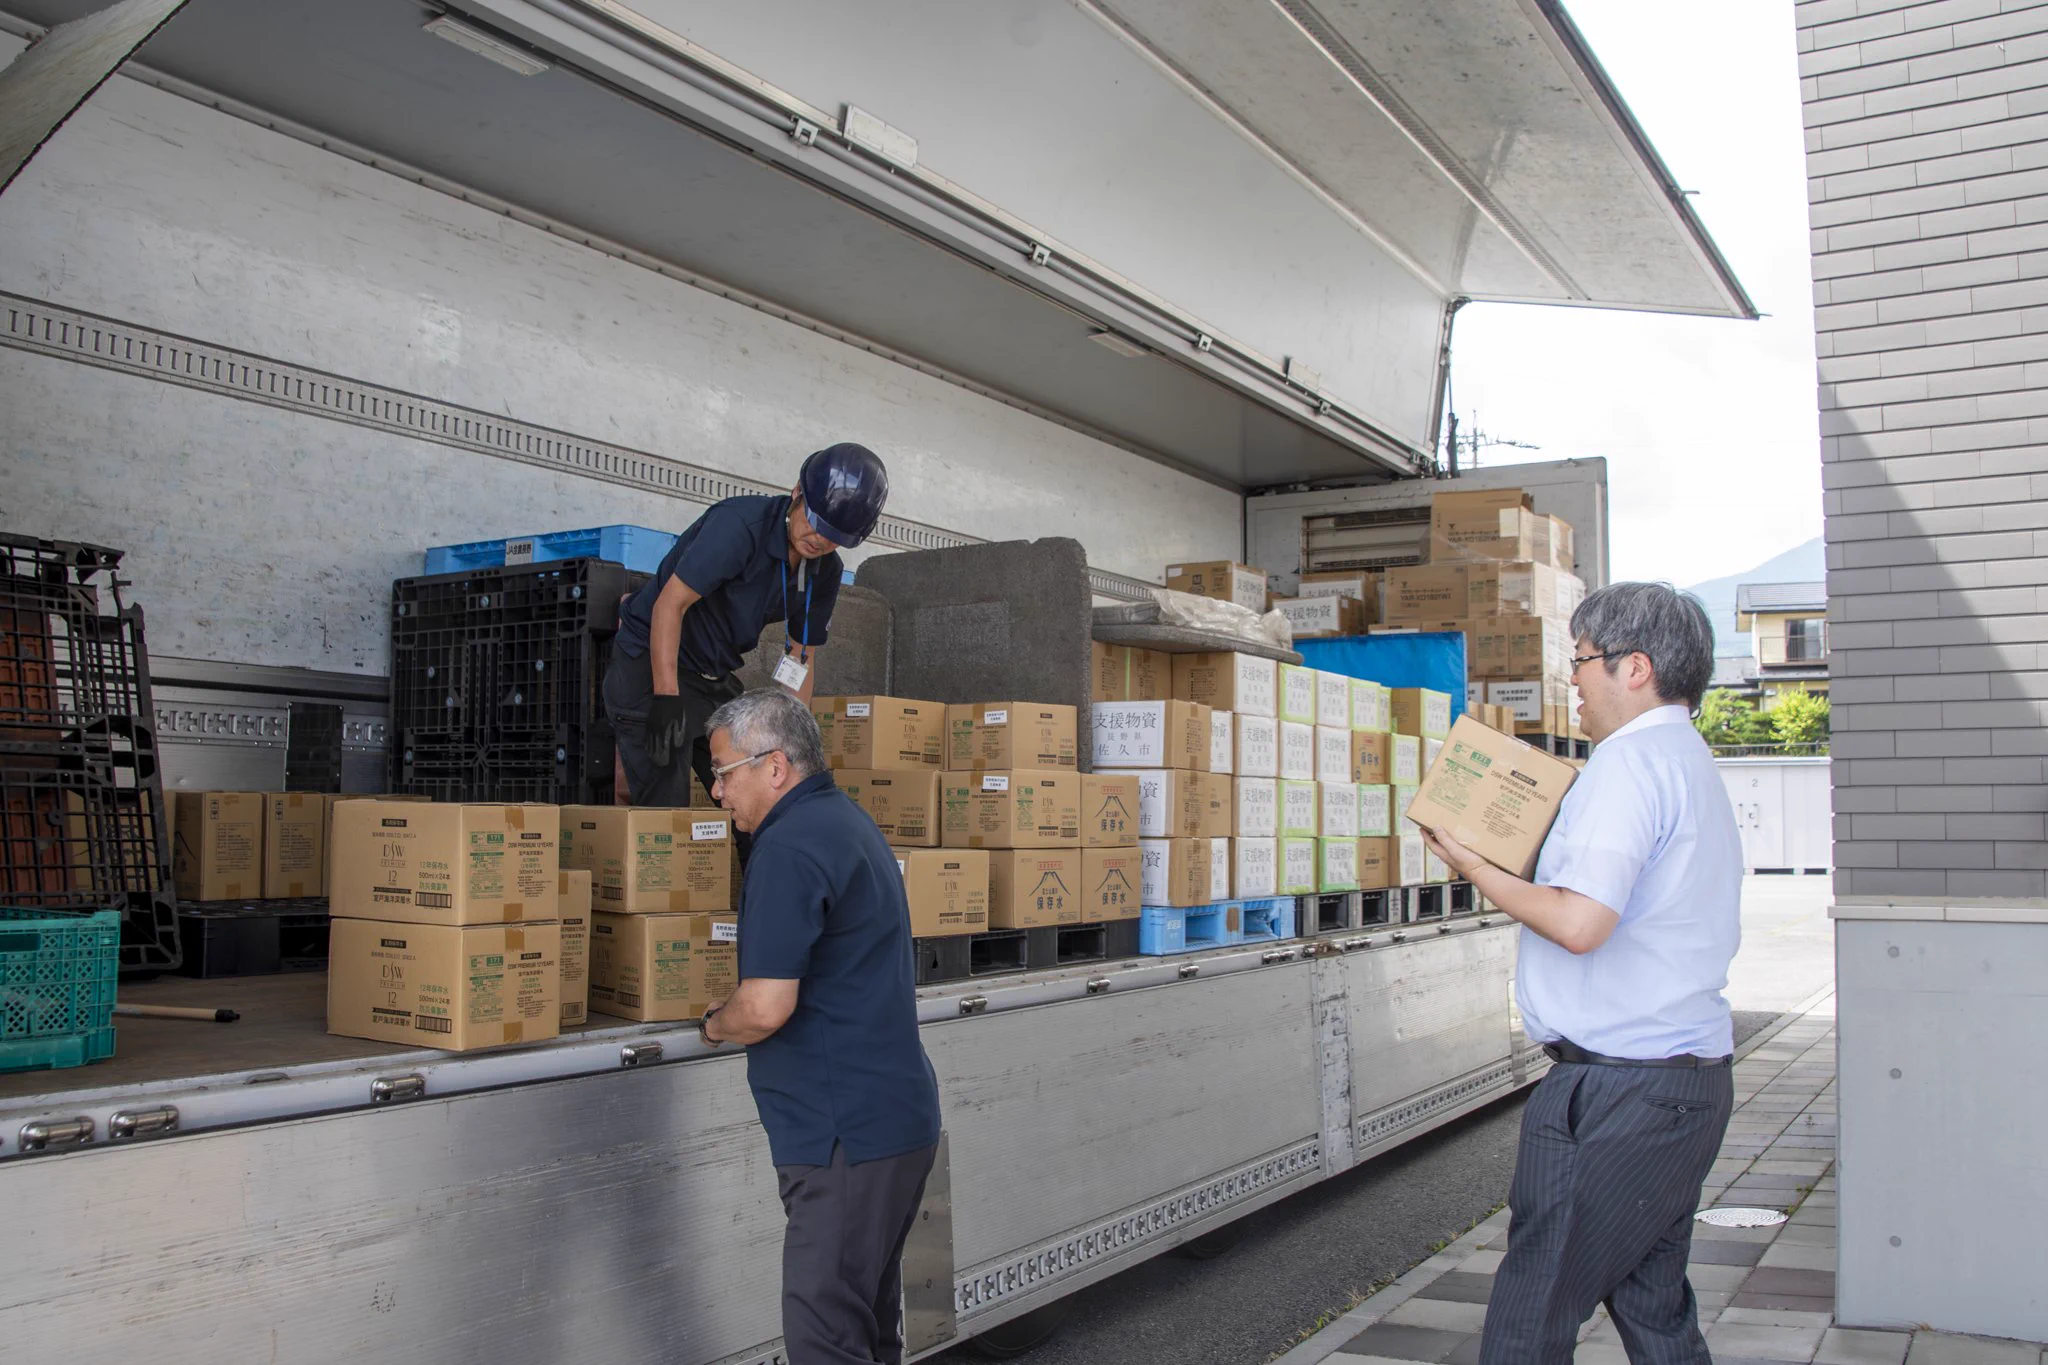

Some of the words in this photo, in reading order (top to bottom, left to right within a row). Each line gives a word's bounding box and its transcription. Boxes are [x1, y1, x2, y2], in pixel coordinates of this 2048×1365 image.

[1242, 665, 1269, 682] 支援物資
[1094, 711, 1157, 729] 支援物資
[1107, 732, 1142, 742] 長野県
[1099, 744, 1151, 757] 佐久市
[1490, 770, 1502, 779] DSW
[1503, 776, 1525, 790] PREMIUM
[1752, 778, 1759, 787] 2
[1244, 787, 1272, 803] 支援物資
[1101, 819, 1124, 832] 保存水
[383, 841, 405, 860] DSW
[388, 870, 397, 882] 12
[1143, 883, 1155, 897] 市
[1037, 897, 1063, 909] 保存水
[1102, 892, 1126, 905] 保存水
[382, 963, 404, 980] DSW
[388, 992, 396, 1003] 12
